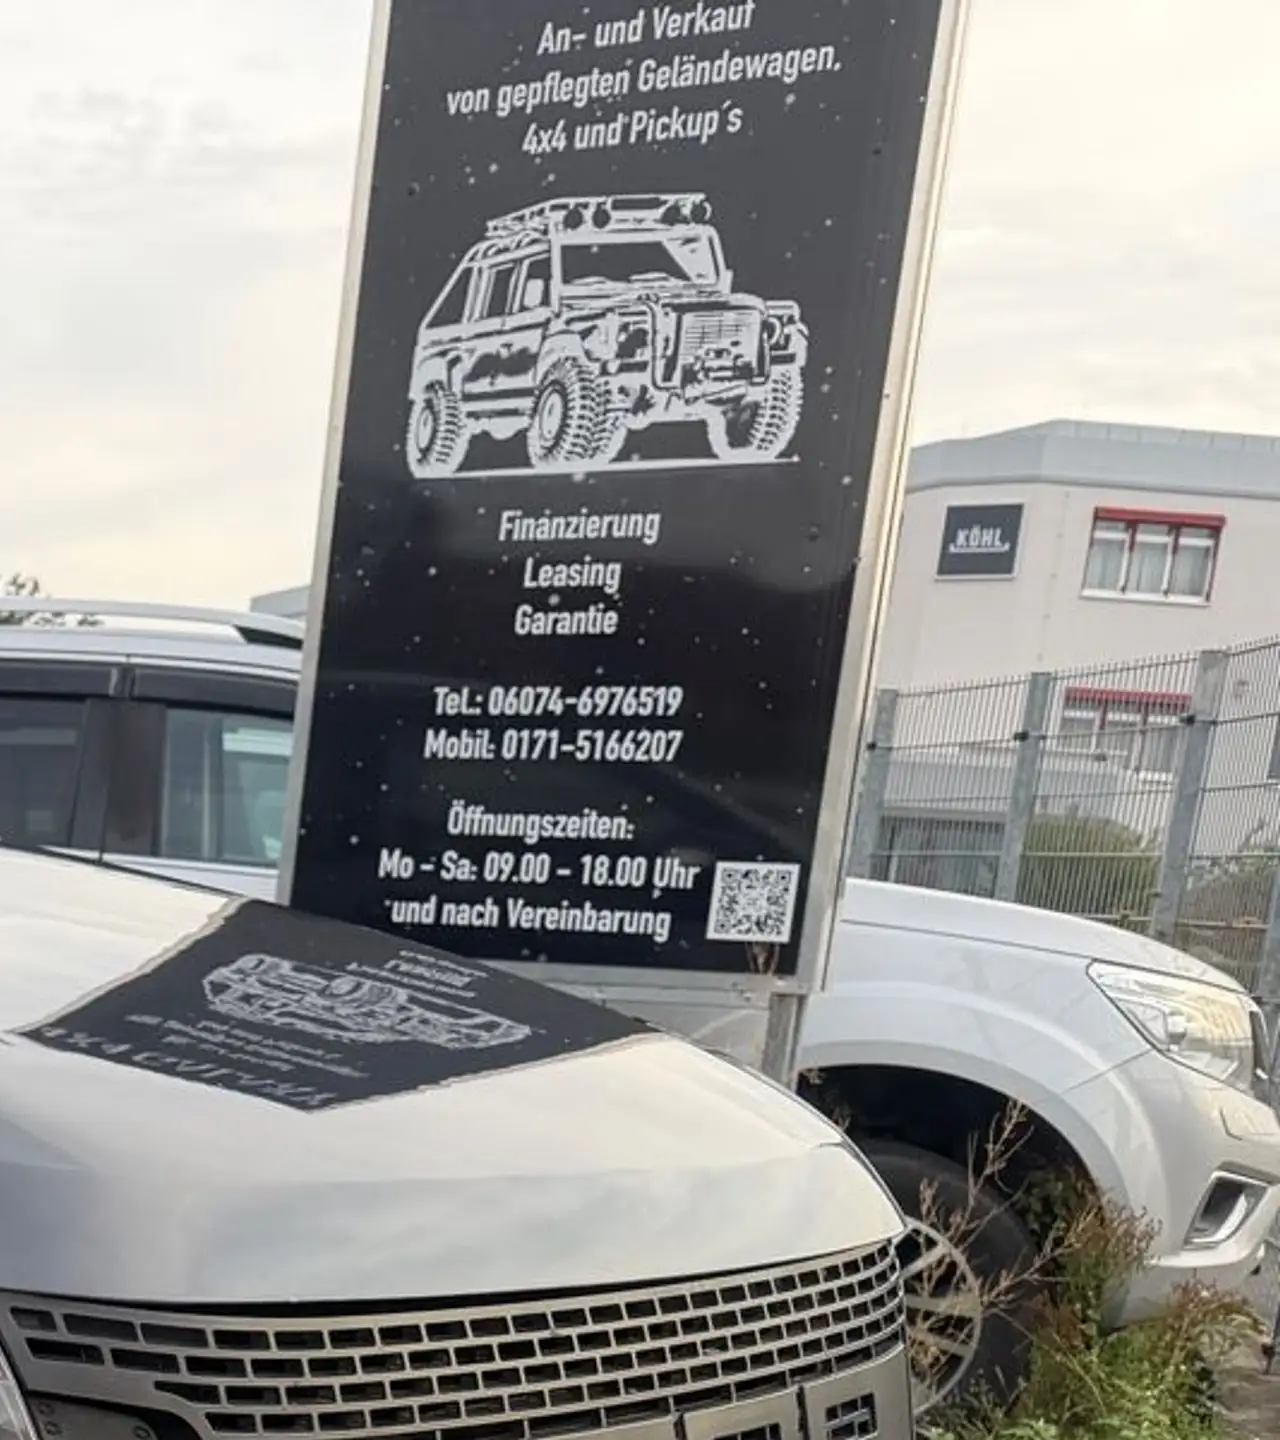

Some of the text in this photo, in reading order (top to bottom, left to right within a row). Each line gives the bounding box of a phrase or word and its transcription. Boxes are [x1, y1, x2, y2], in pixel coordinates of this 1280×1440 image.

[537, 0, 756, 56] An- und Verkauf
[447, 43, 842, 121] von gepflegten Geländewagen.
[523, 122, 567, 155] 4x4
[575, 114, 624, 149] und
[498, 511, 661, 544] Finanzierung
[956, 524, 1002, 547] KÖHL
[524, 559, 621, 594] Leasing
[515, 605, 618, 636] Garantie
[434, 686, 683, 716] Tel.: 06074-6976519
[424, 731, 683, 761] Mobil: 0171-5166207
[447, 800, 634, 841] Öffnungszeiten:
[378, 849, 414, 879] Mo
[441, 853, 477, 882] Sa:
[483, 855, 550, 883] 09.00
[579, 858, 646, 887] 18.00
[653, 860, 700, 890] Uhr
[391, 896, 671, 942] und nach Vereinbarung
